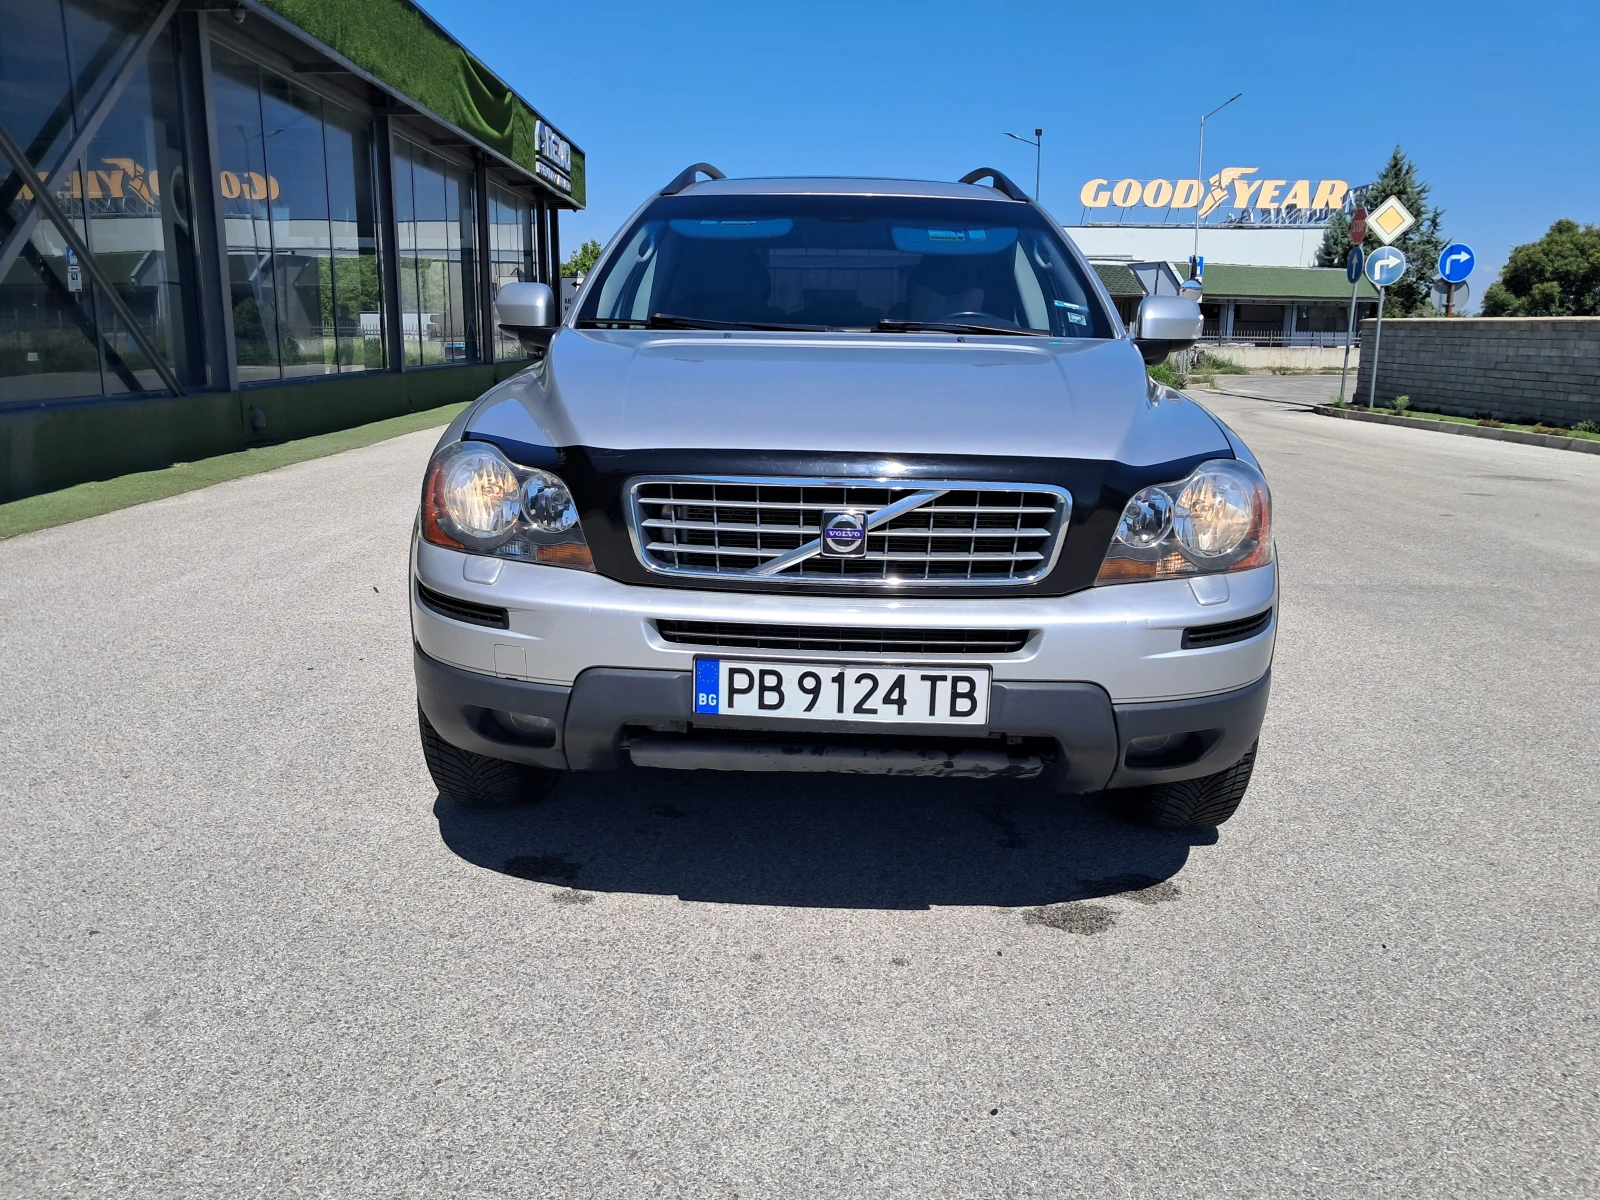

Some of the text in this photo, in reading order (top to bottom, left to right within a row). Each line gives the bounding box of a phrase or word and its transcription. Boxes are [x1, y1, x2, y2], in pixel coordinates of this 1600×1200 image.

[1352, 219, 1365, 233] STOP
[727, 667, 978, 717] PB 9124 TB
[698, 693, 717, 706] BG
